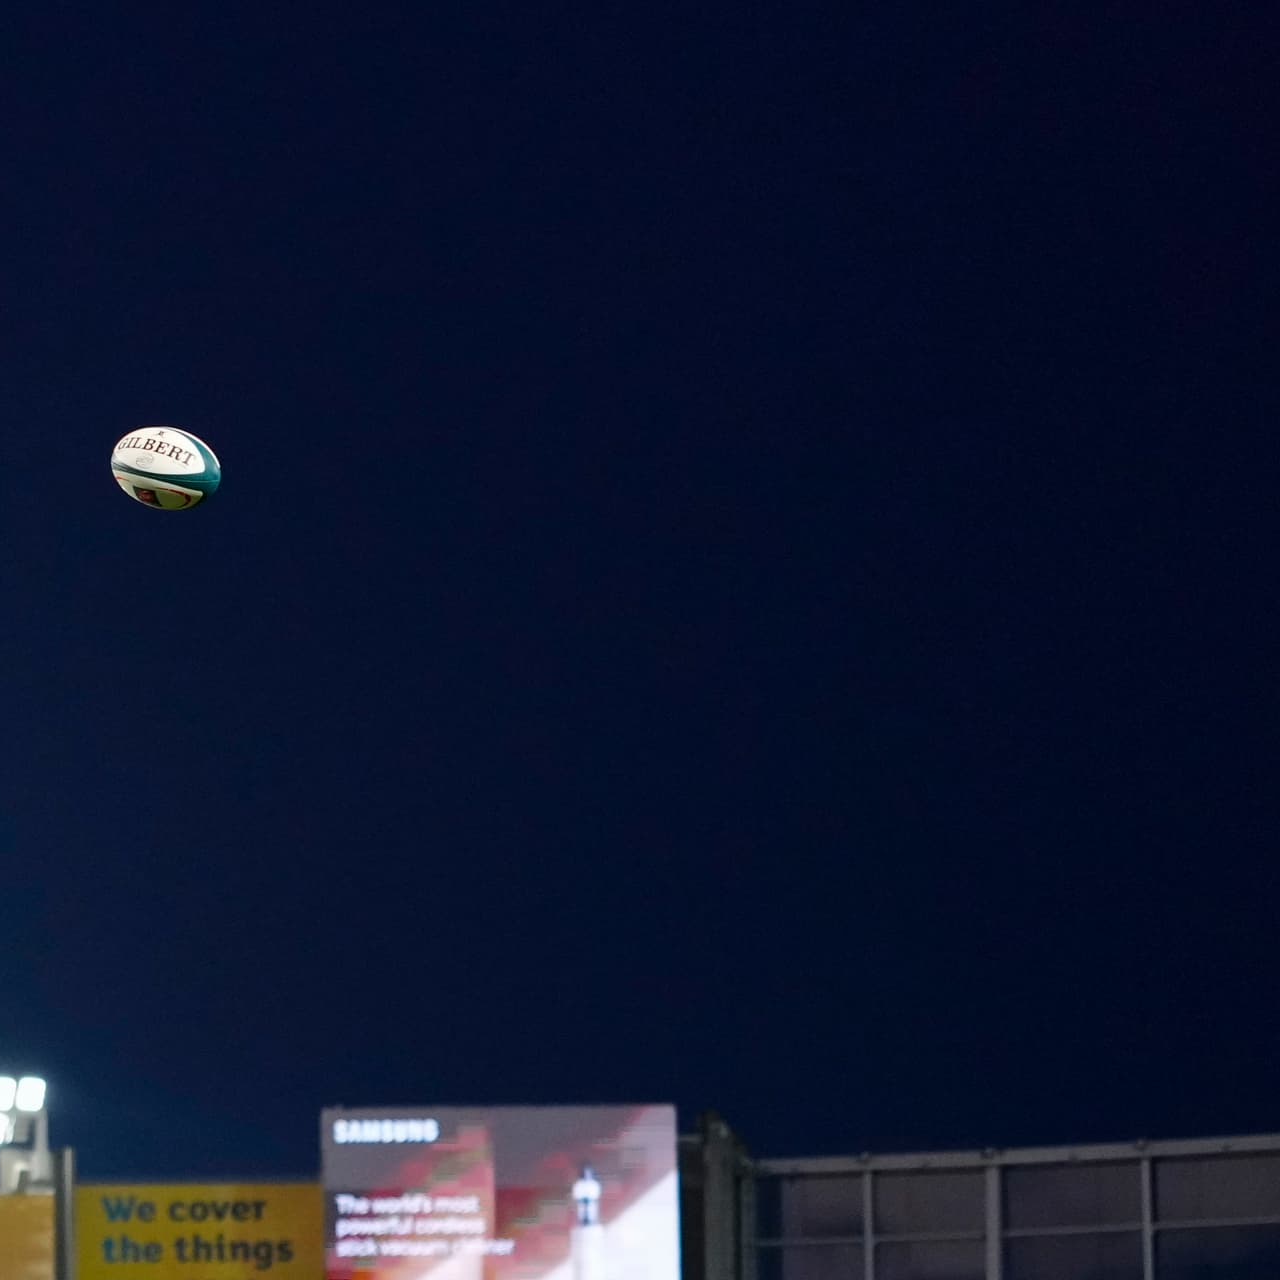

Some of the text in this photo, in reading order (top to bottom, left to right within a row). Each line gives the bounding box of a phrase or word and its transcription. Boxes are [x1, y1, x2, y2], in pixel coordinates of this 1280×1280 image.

[118, 437, 195, 466] GILBERT
[334, 1119, 439, 1143] SAMSUNG
[102, 1195, 267, 1223] We cover
[102, 1234, 294, 1270] the things
